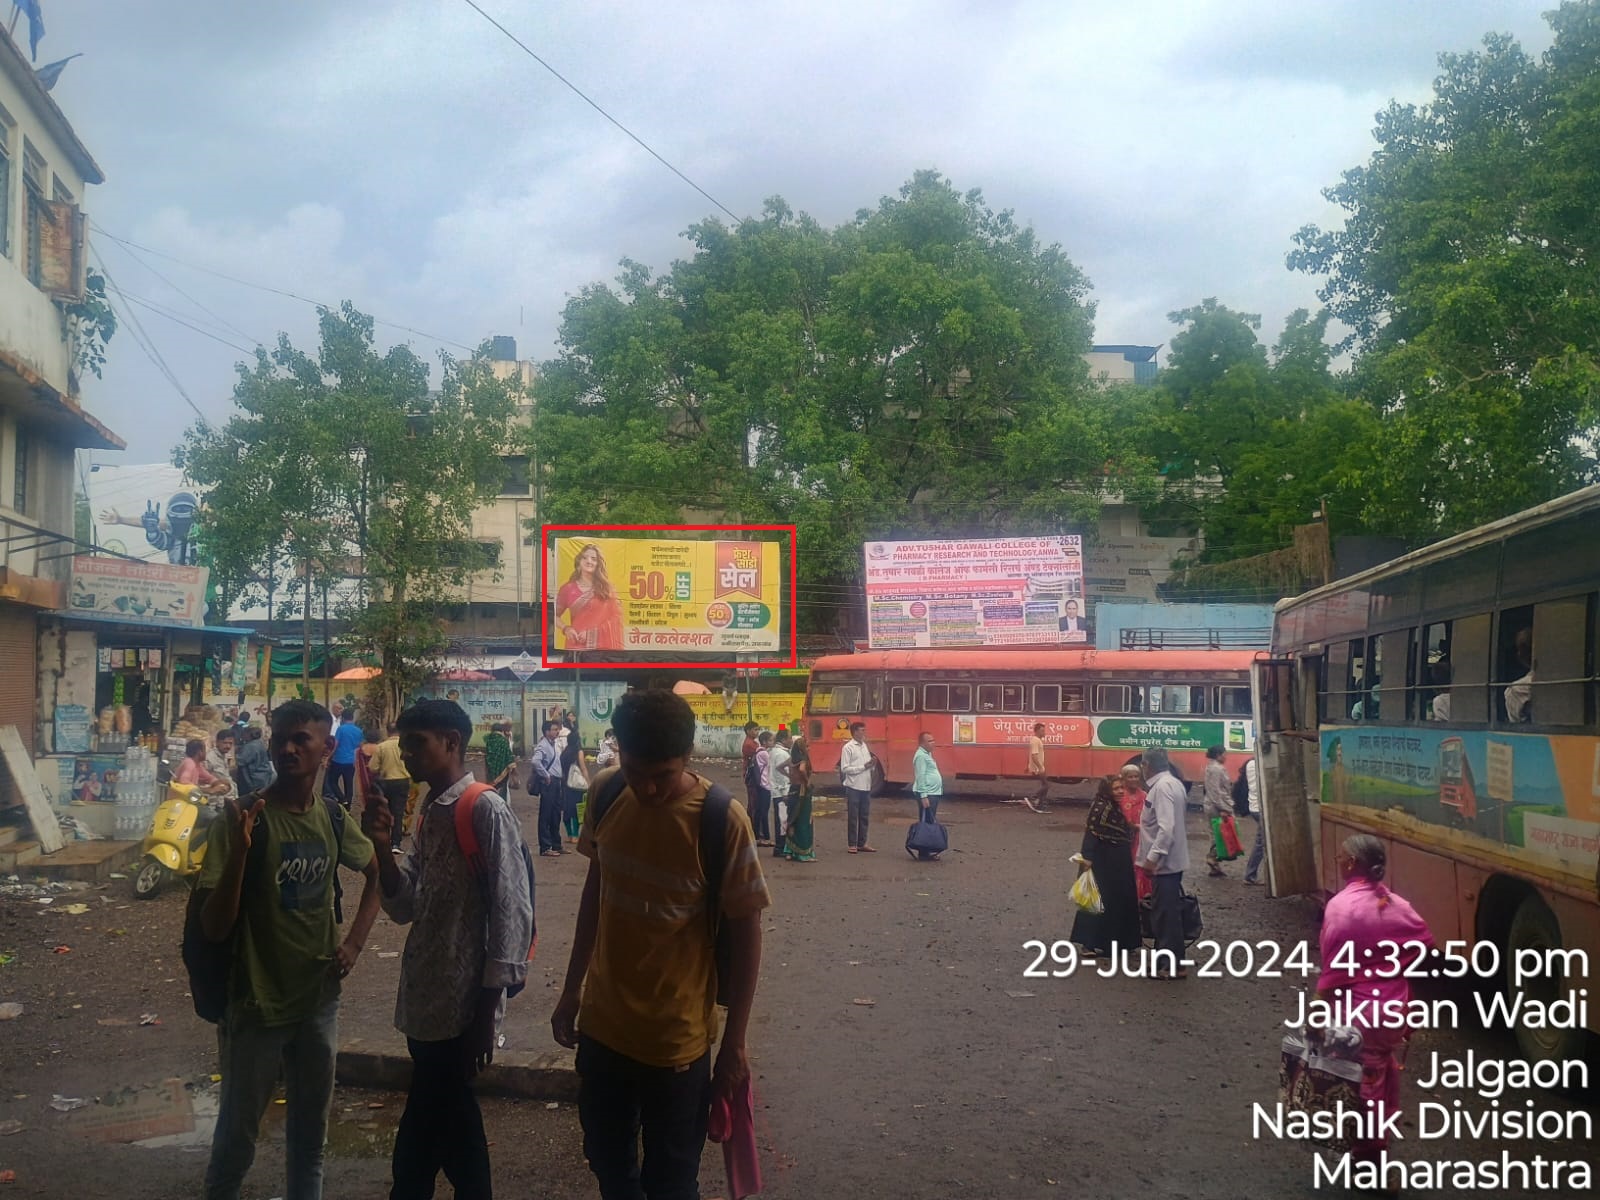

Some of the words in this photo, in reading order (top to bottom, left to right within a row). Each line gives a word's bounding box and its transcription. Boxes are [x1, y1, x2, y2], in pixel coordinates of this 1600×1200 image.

[893, 552, 933, 561] PHARMACY
[934, 550, 971, 561] RESEARCH
[973, 550, 988, 558] AND
[956, 543, 991, 551] GAWALI
[994, 541, 1036, 549] COLLEGE
[1039, 540, 1051, 548] OF
[719, 562, 758, 588] सेल
[676, 575, 690, 598] OFF
[629, 626, 653, 645] जैन
[654, 628, 714, 647] कलेक्शन
